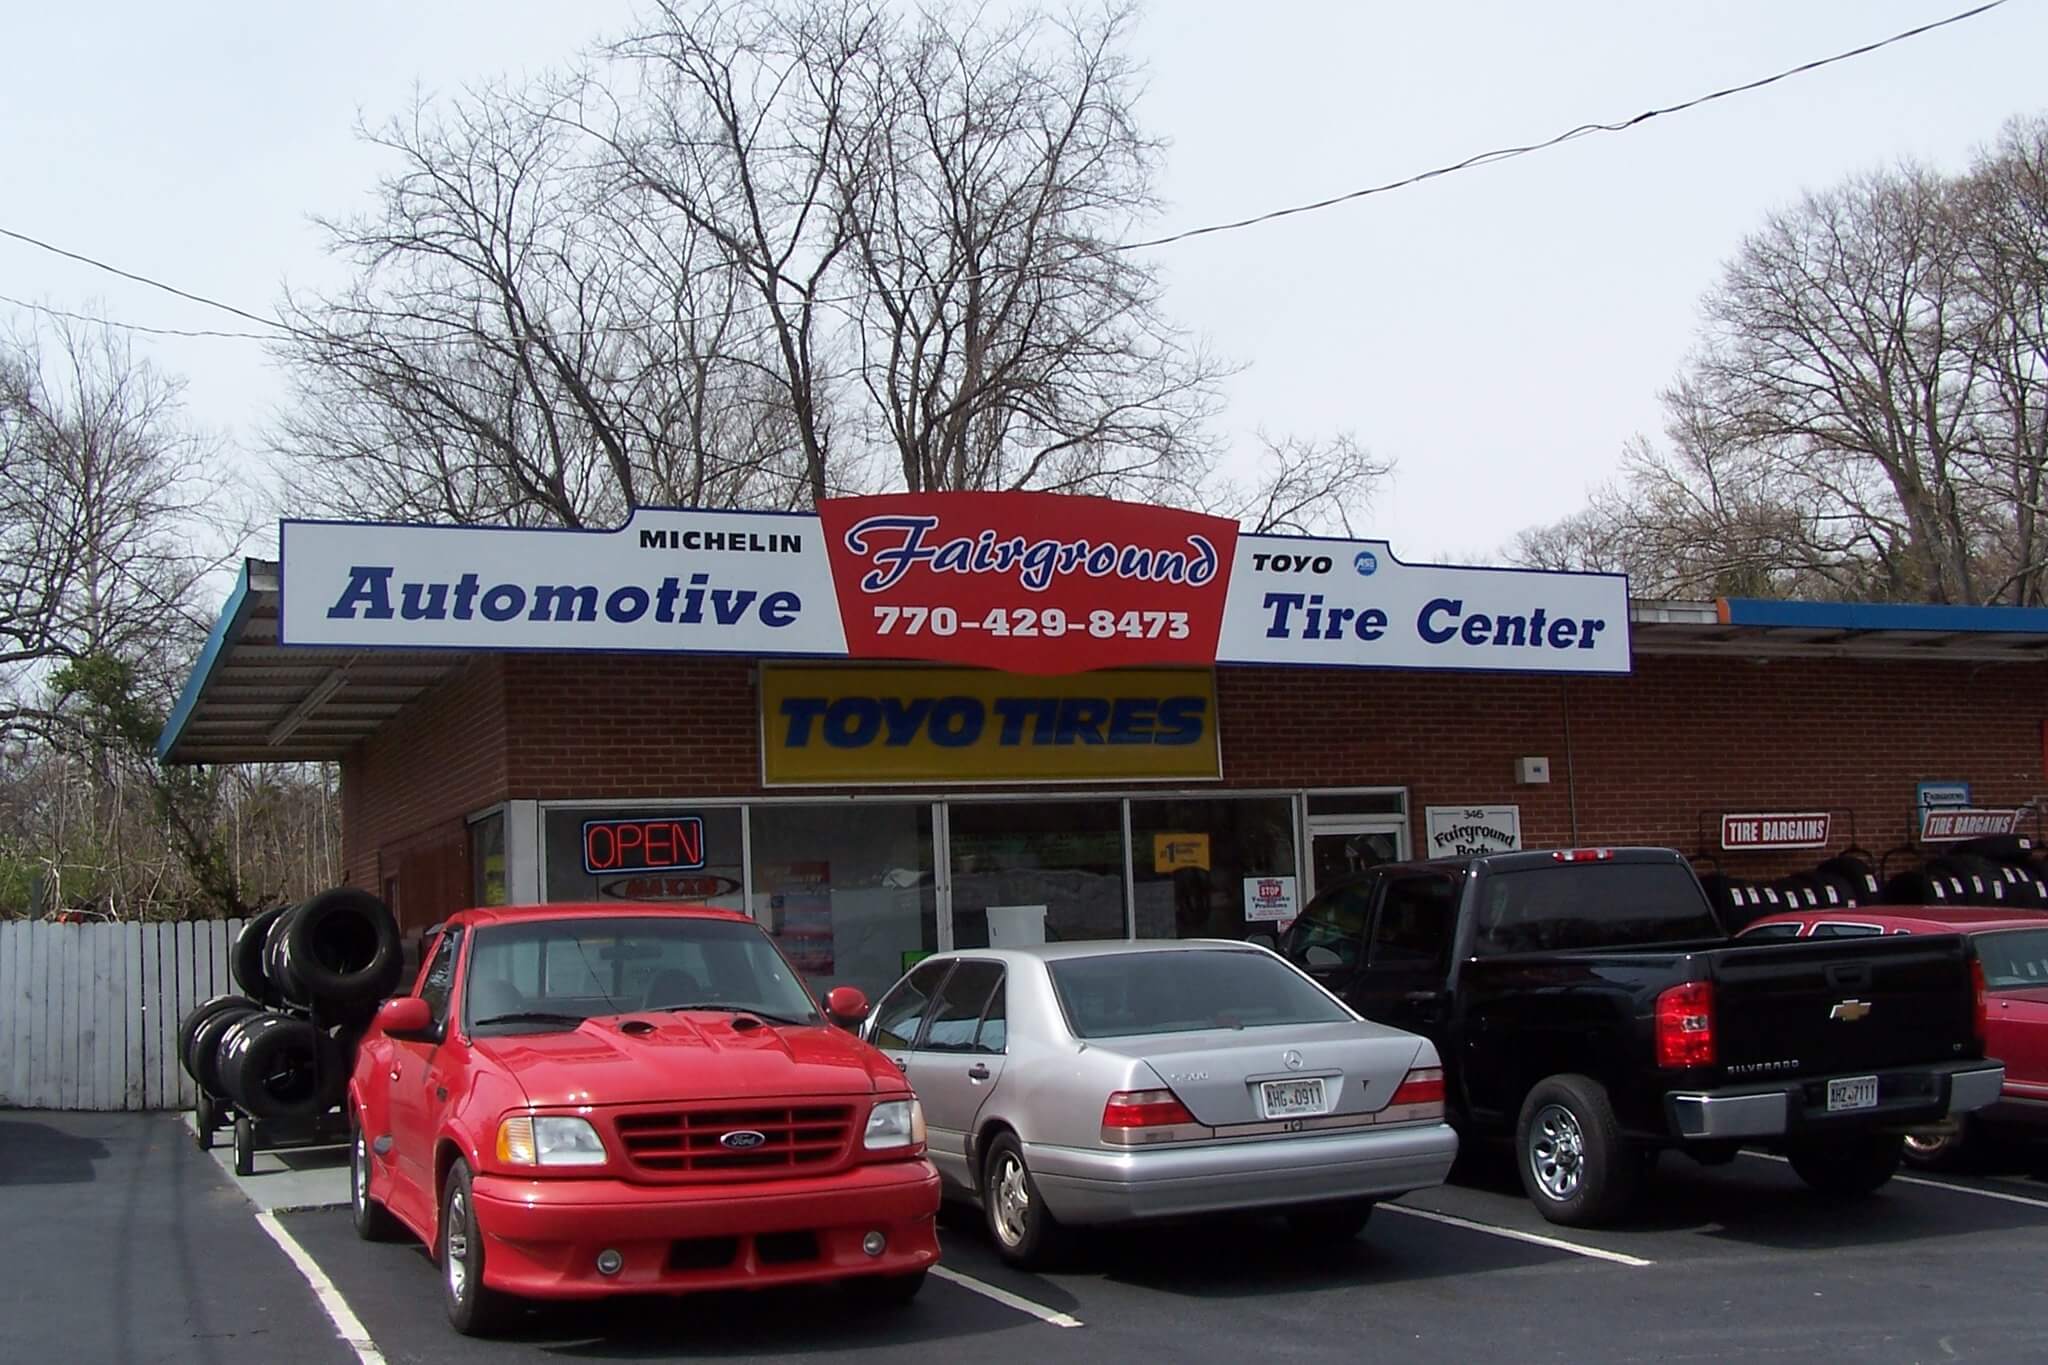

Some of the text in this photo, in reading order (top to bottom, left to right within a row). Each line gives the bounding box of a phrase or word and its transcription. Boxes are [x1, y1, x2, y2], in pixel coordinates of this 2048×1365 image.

[640, 529, 801, 553] MICHELIN
[844, 515, 1217, 592] Fairground
[1252, 553, 1332, 574] TOYO
[326, 566, 801, 627] Automotive
[874, 606, 1190, 639] 770-429-8473
[1263, 592, 1605, 649] Tire Center
[780, 696, 1205, 748] TOYO TIRES
[1463, 809, 1485, 819] 346
[1928, 815, 2011, 836] TIRE BARGAINS
[1434, 824, 1515, 848] Fairground
[1728, 819, 1824, 843] TIRE BARGAINS
[588, 822, 699, 869] OPEN
[1456, 844, 1494, 856] Bod
[1261, 886, 1280, 896] STOP
[1727, 1059, 1799, 1073] SILVERADO
[1267, 1087, 1322, 1108] AHG 0911
[731, 1134, 756, 1146] Ford
